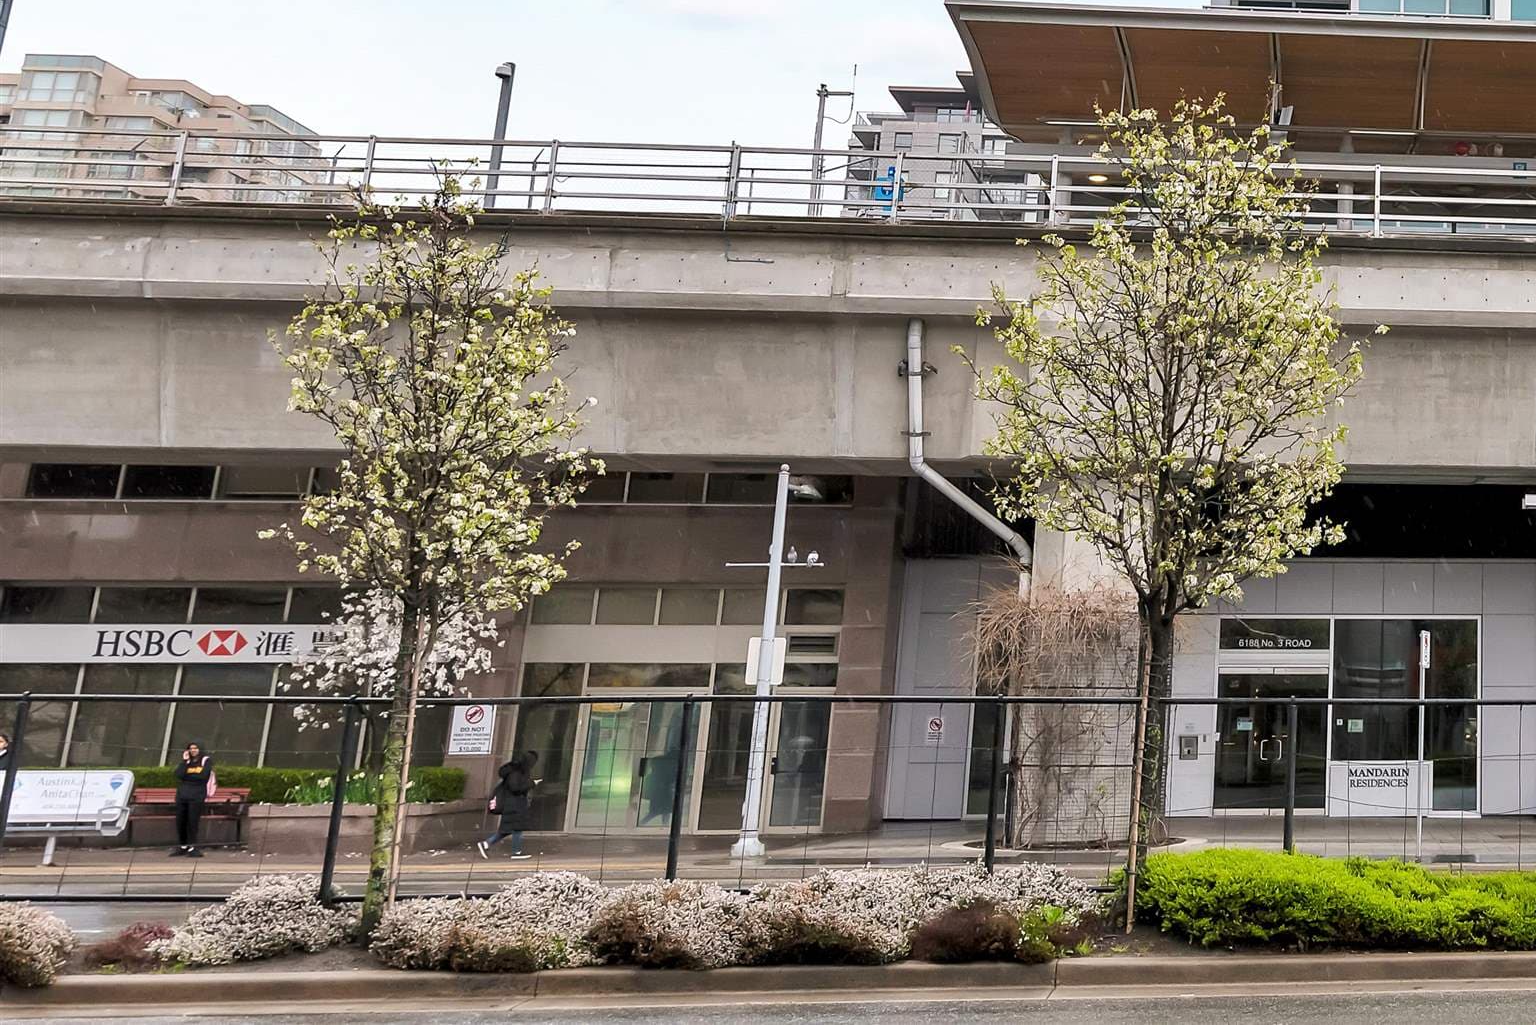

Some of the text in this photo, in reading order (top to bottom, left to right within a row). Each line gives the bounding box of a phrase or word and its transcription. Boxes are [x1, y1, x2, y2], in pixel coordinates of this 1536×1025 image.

[92, 630, 194, 657] HSBC
[1238, 638, 1260, 648] 6188
[1277, 639, 1284, 648] 3
[1285, 639, 1312, 648] ROAD
[1348, 767, 1410, 778] MANDARIN
[1349, 778, 1409, 788] RESIDENCES
